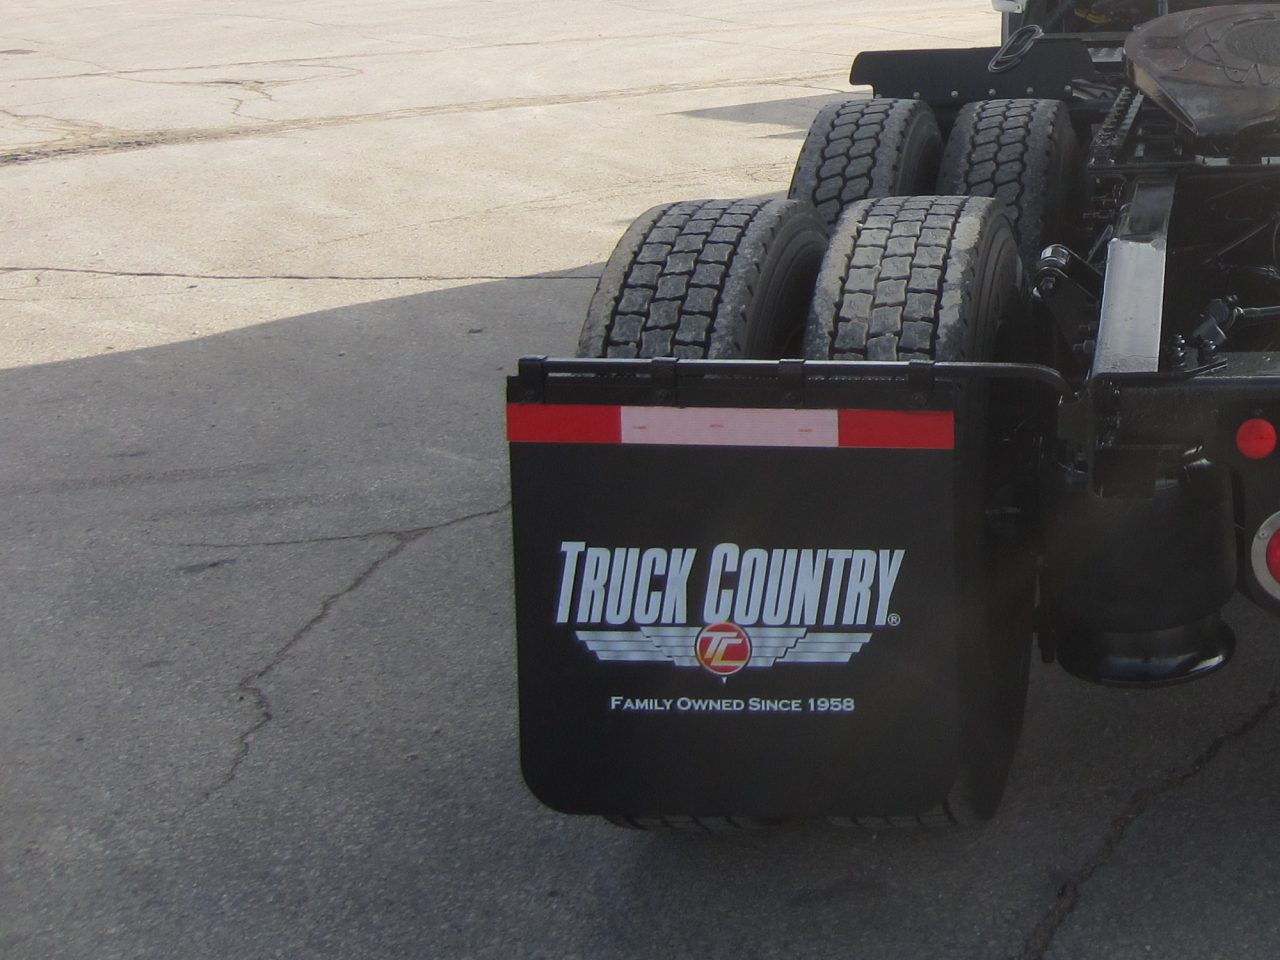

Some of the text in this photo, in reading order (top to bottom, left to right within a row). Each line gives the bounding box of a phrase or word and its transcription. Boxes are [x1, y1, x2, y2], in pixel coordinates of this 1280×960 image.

[556, 541, 906, 626] TRUCK COUNTRY
[610, 696, 855, 712] FAMILY OWNED SINCE 1958
